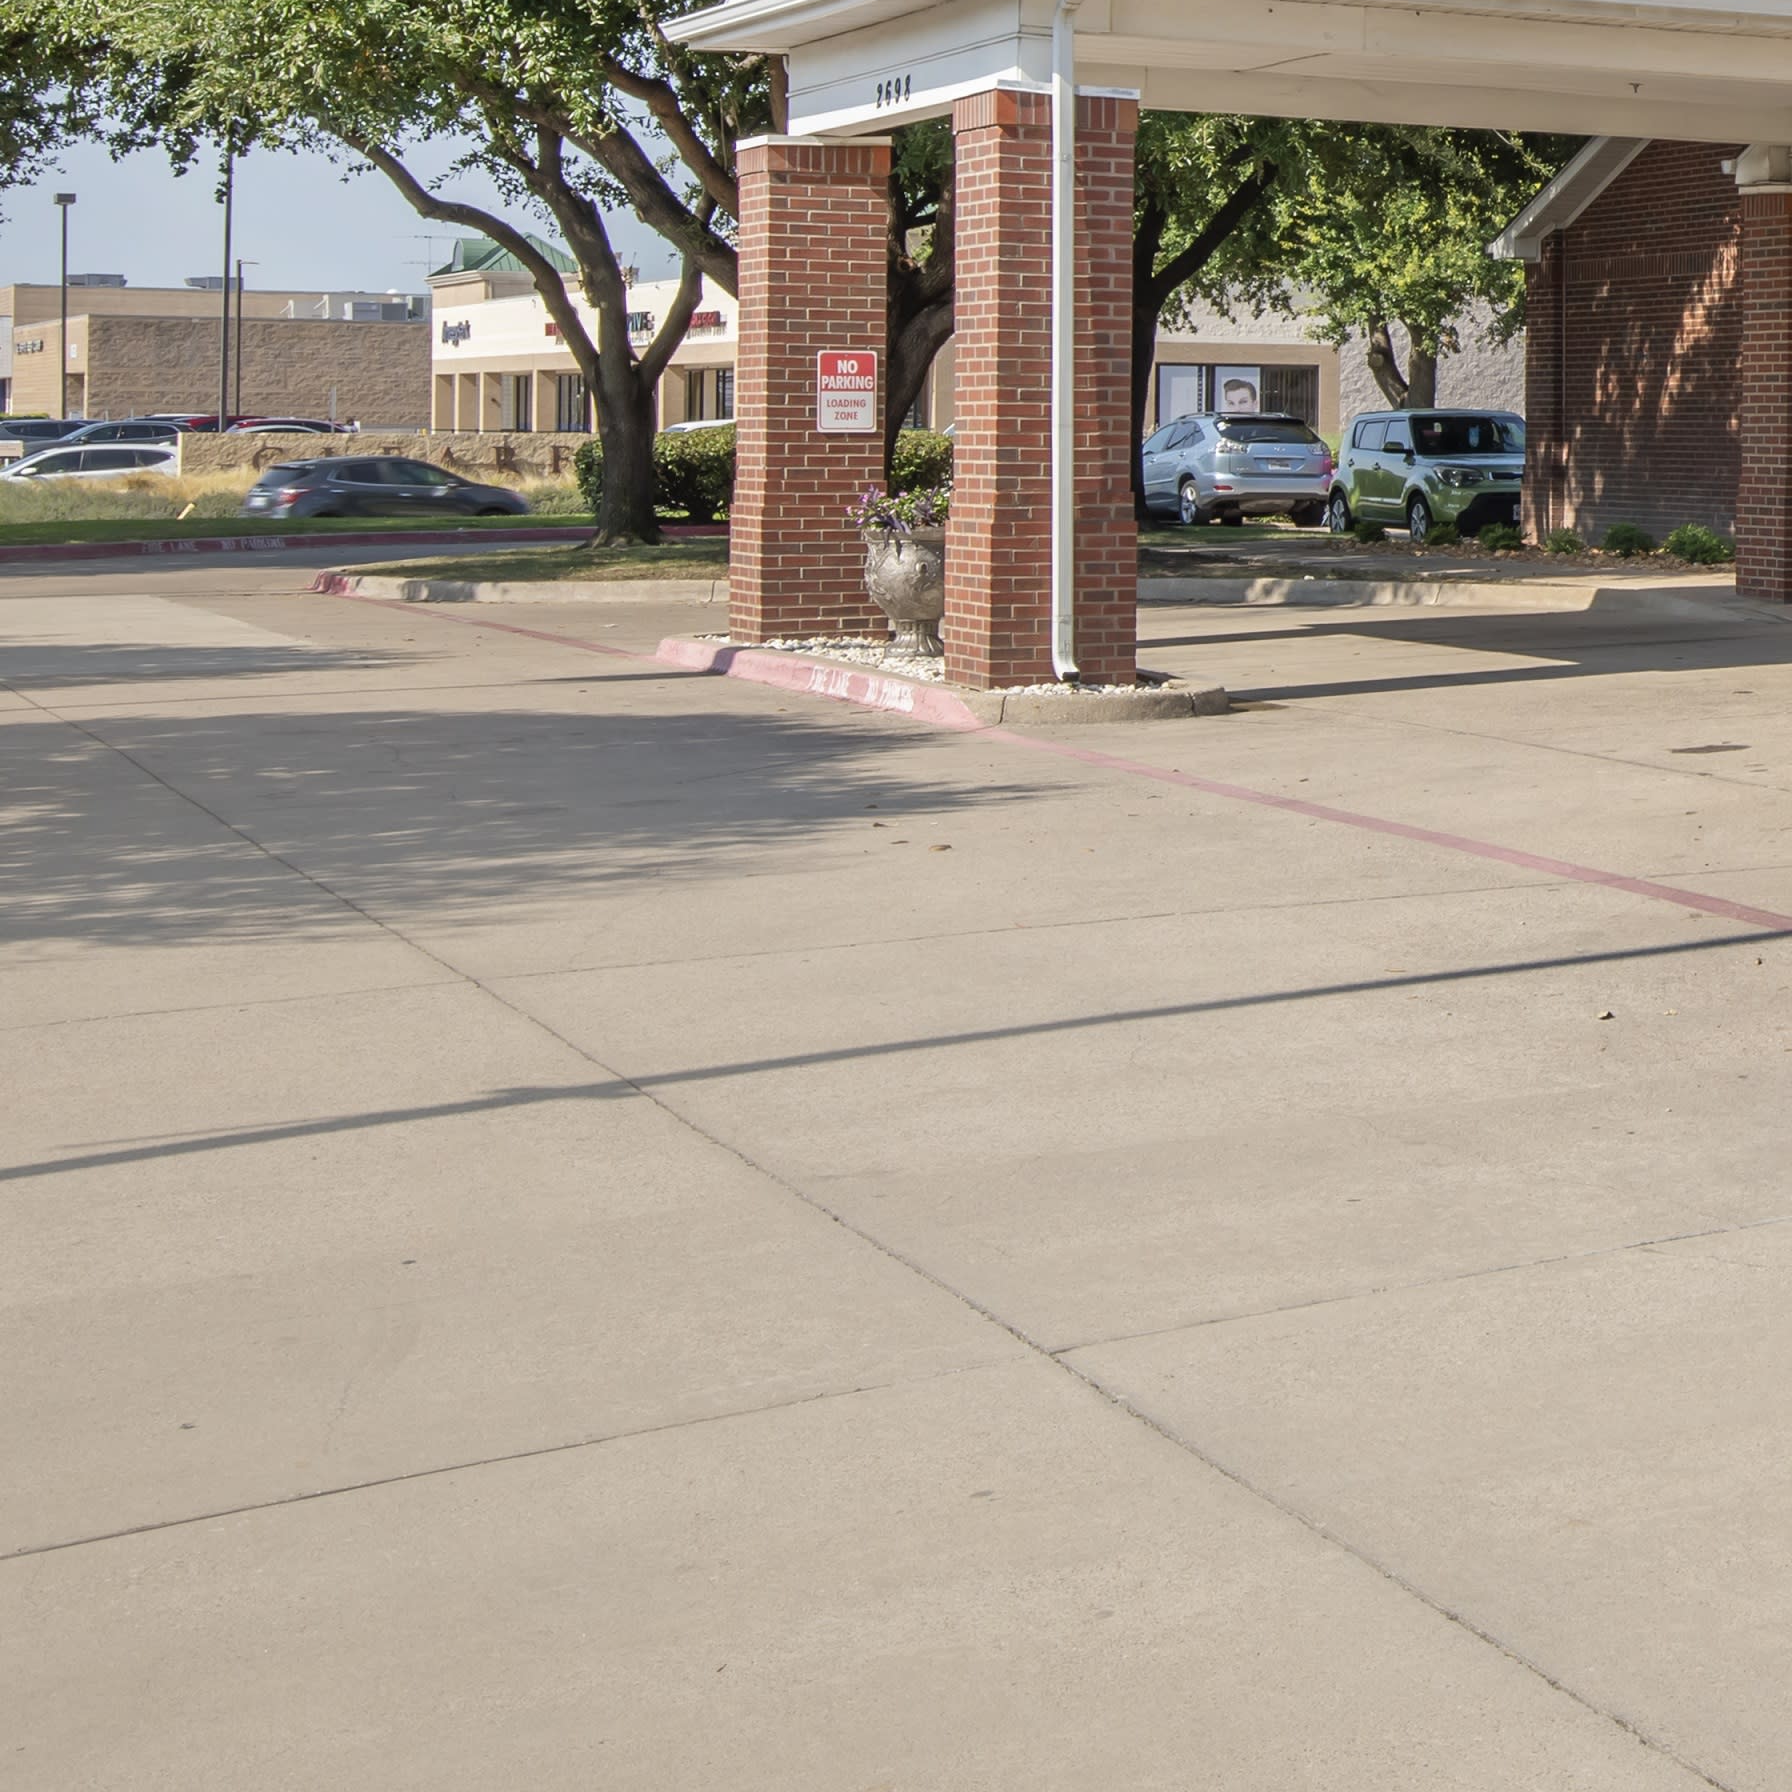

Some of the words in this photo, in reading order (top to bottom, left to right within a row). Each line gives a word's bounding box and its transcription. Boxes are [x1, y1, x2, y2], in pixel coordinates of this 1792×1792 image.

[876, 73, 911, 109] 2698
[836, 359, 859, 374] NO
[821, 375, 874, 390] PARKING
[826, 398, 867, 408] LOADING
[834, 411, 858, 421] ZONE
